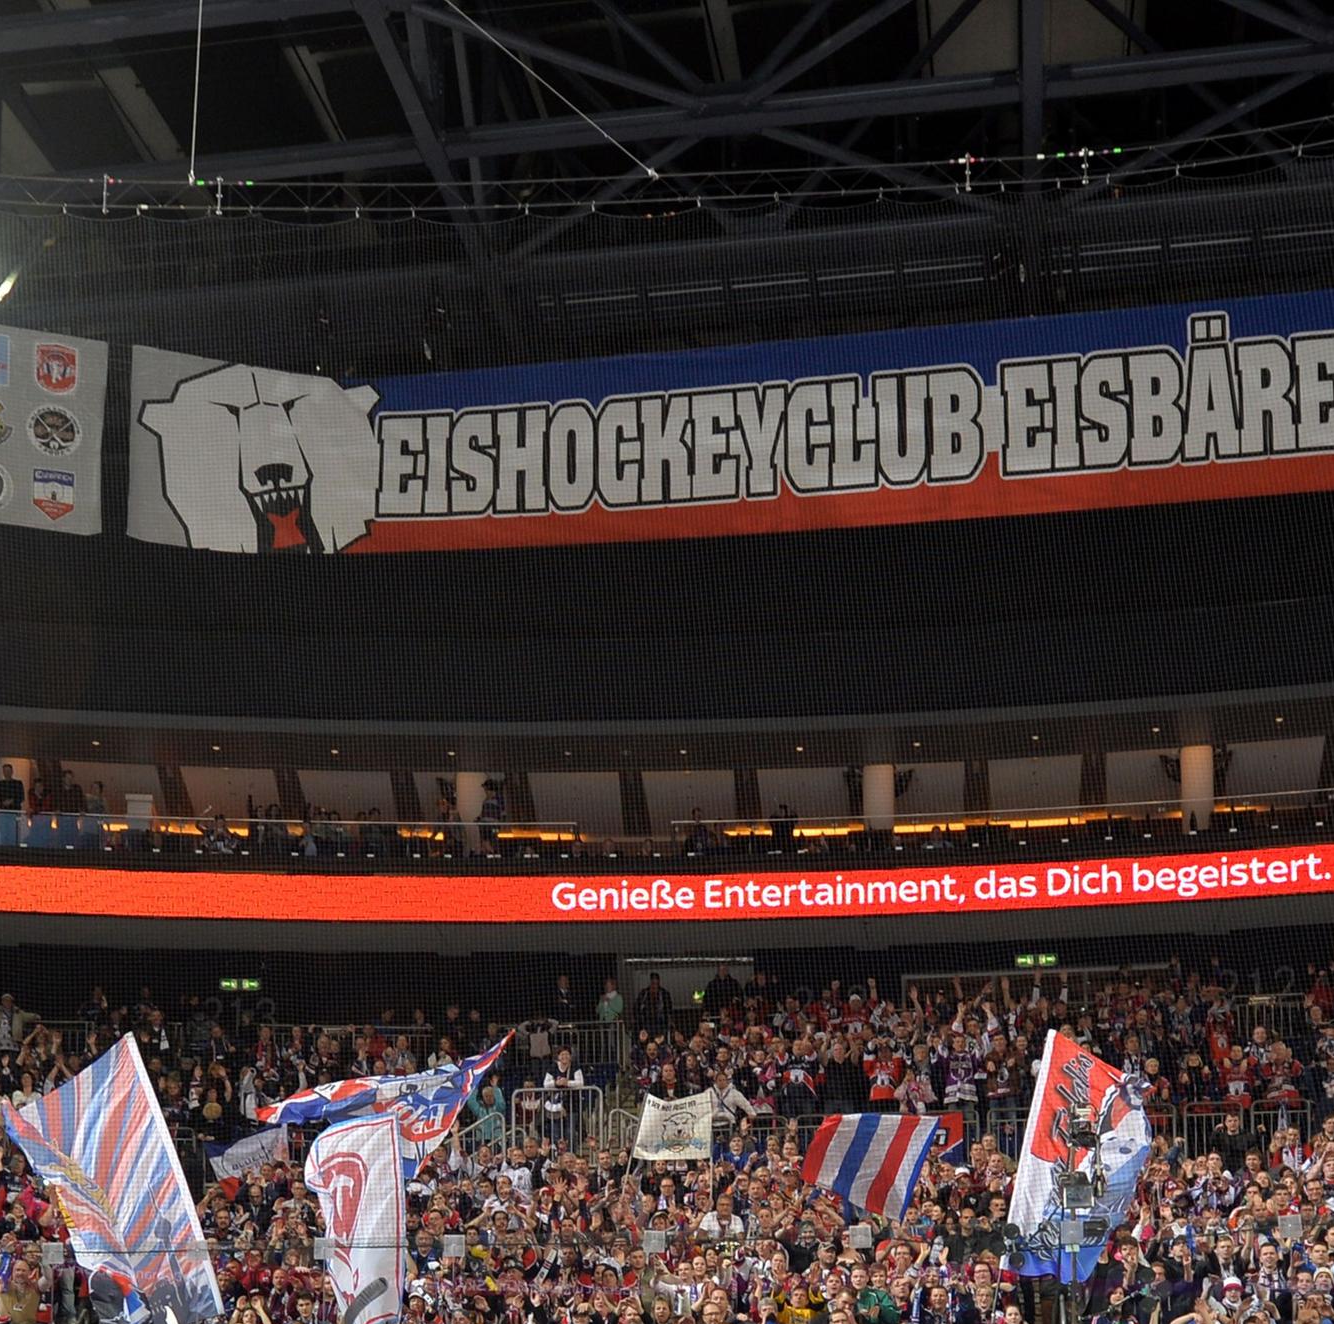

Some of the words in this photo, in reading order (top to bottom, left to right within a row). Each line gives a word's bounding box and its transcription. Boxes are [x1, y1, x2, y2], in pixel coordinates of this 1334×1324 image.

[373, 362, 985, 520] EISHOCKEYCLUB
[550, 881, 695, 913] Genieße
[703, 874, 967, 909] Entertainment,
[972, 869, 1038, 900] das
[1046, 866, 1123, 897] Dich
[1131, 855, 1332, 898] begeistert.
